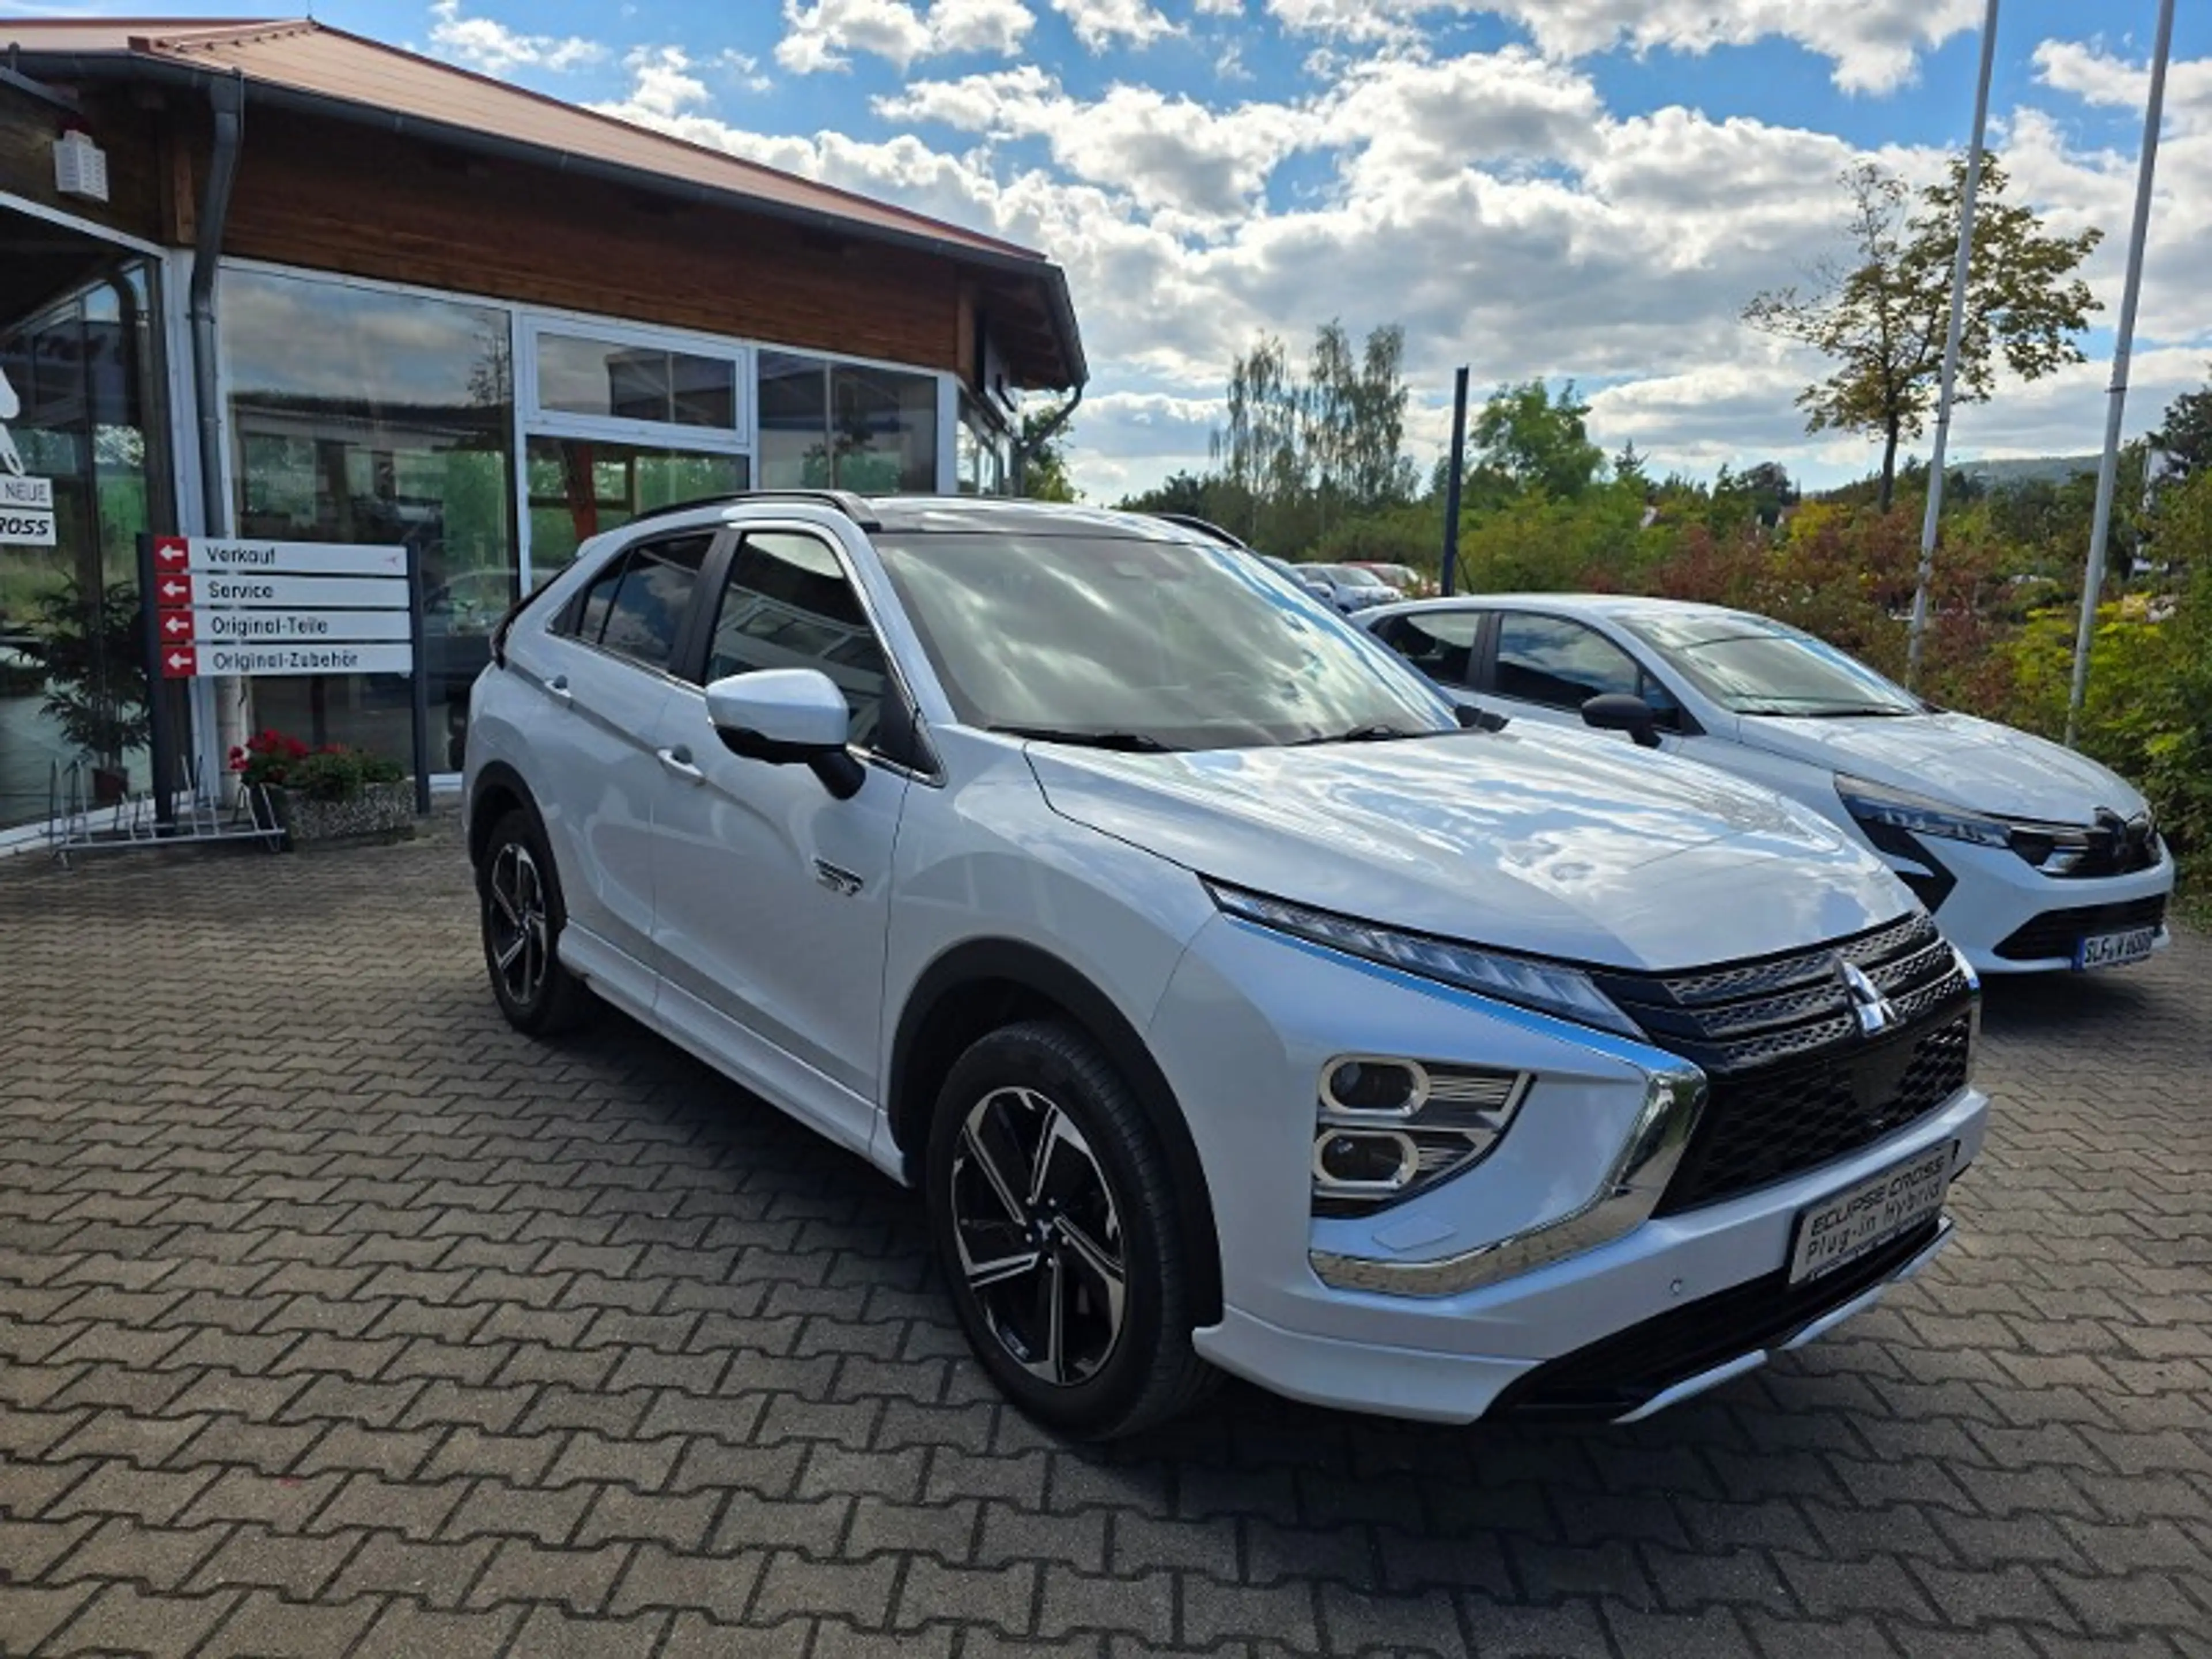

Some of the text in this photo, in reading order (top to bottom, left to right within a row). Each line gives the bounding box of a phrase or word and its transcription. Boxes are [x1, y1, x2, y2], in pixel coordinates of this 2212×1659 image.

[206, 547, 275, 565] Verkauf
[208, 580, 274, 599] Service
[211, 616, 328, 637] Original-Teile
[213, 649, 358, 672] Original-Zubehör
[1810, 1154, 1945, 1237] ECLIPSE CROSS
